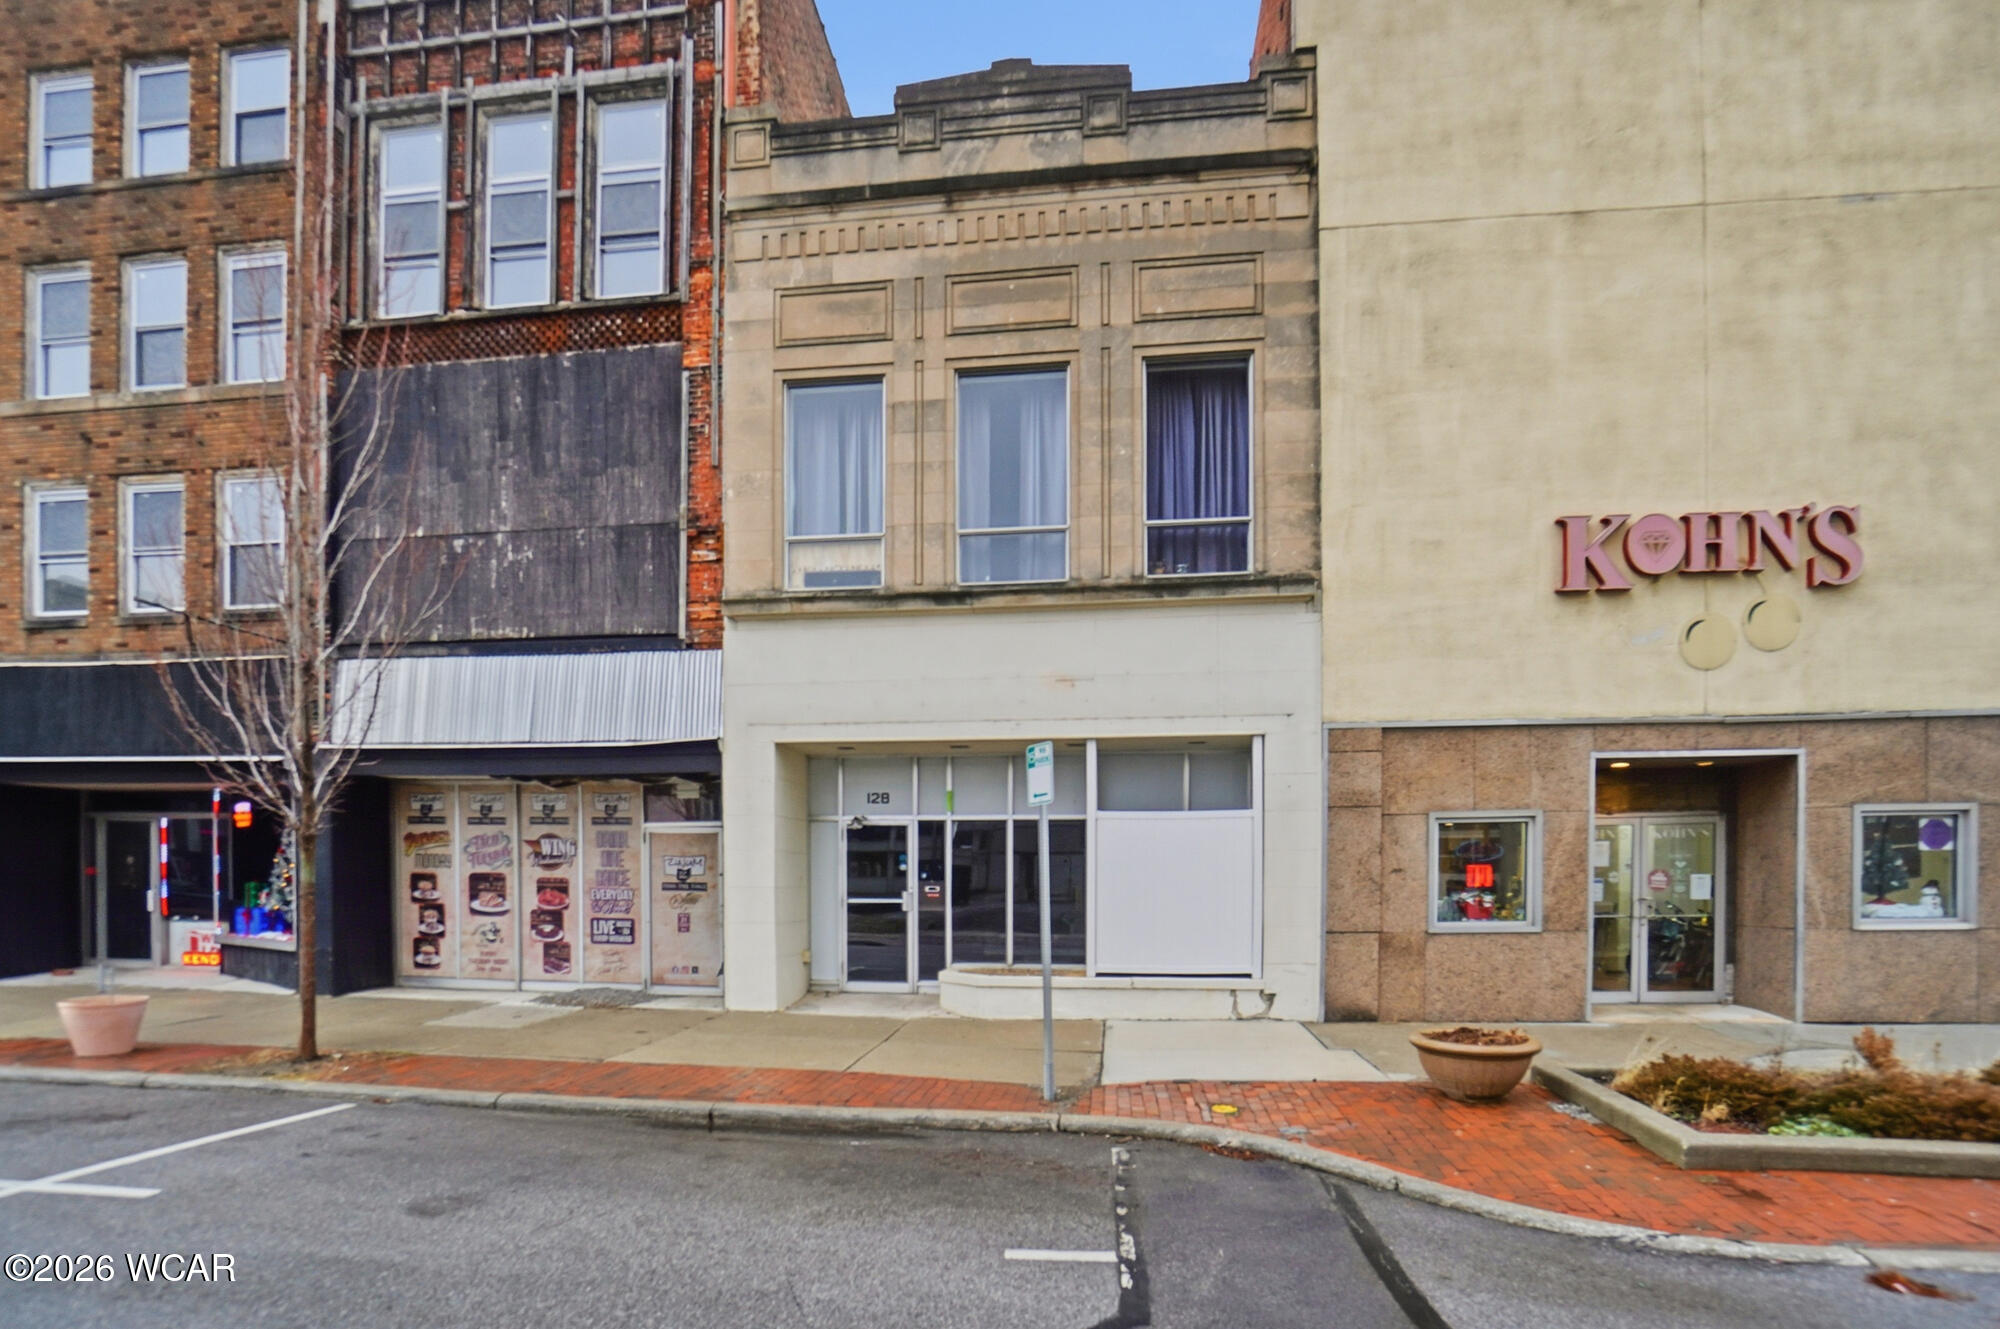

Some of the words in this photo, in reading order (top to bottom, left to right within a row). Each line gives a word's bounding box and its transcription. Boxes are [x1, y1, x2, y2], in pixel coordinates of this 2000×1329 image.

[1554, 502, 1864, 593] KOHN'S
[867, 792, 890, 804] 128
[539, 837, 577, 857] WING
[591, 888, 634, 901] EVERYDAY
[593, 919, 616, 935] LIVE
[183, 953, 220, 965] KENO
